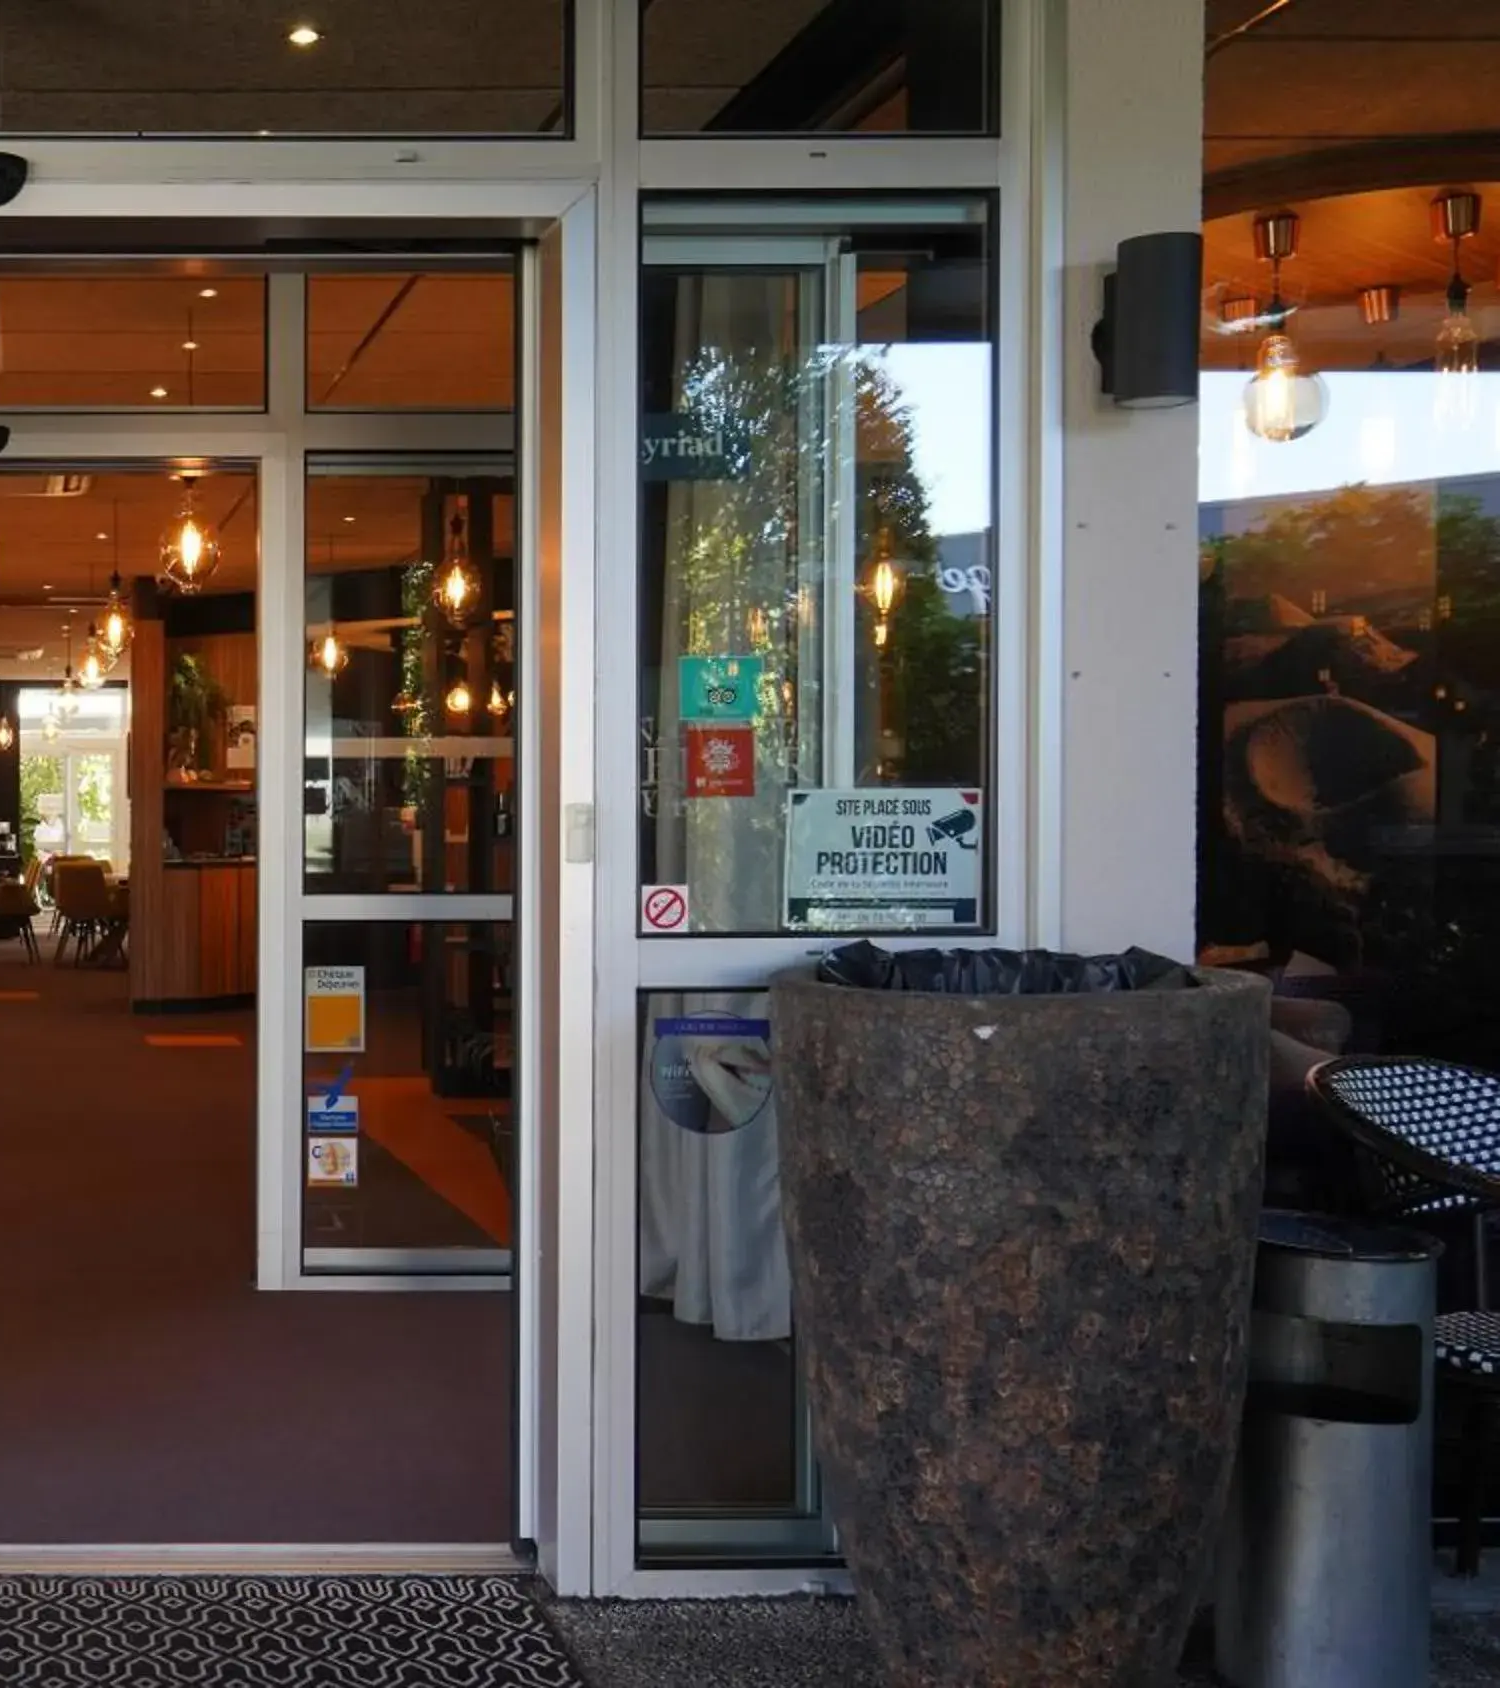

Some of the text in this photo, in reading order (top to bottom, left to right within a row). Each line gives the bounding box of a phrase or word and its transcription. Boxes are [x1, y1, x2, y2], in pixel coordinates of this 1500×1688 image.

[641, 430, 724, 465] yriad
[835, 799, 860, 816] SITE
[903, 799, 932, 816] SOUS
[816, 851, 948, 876] PROTECTION
